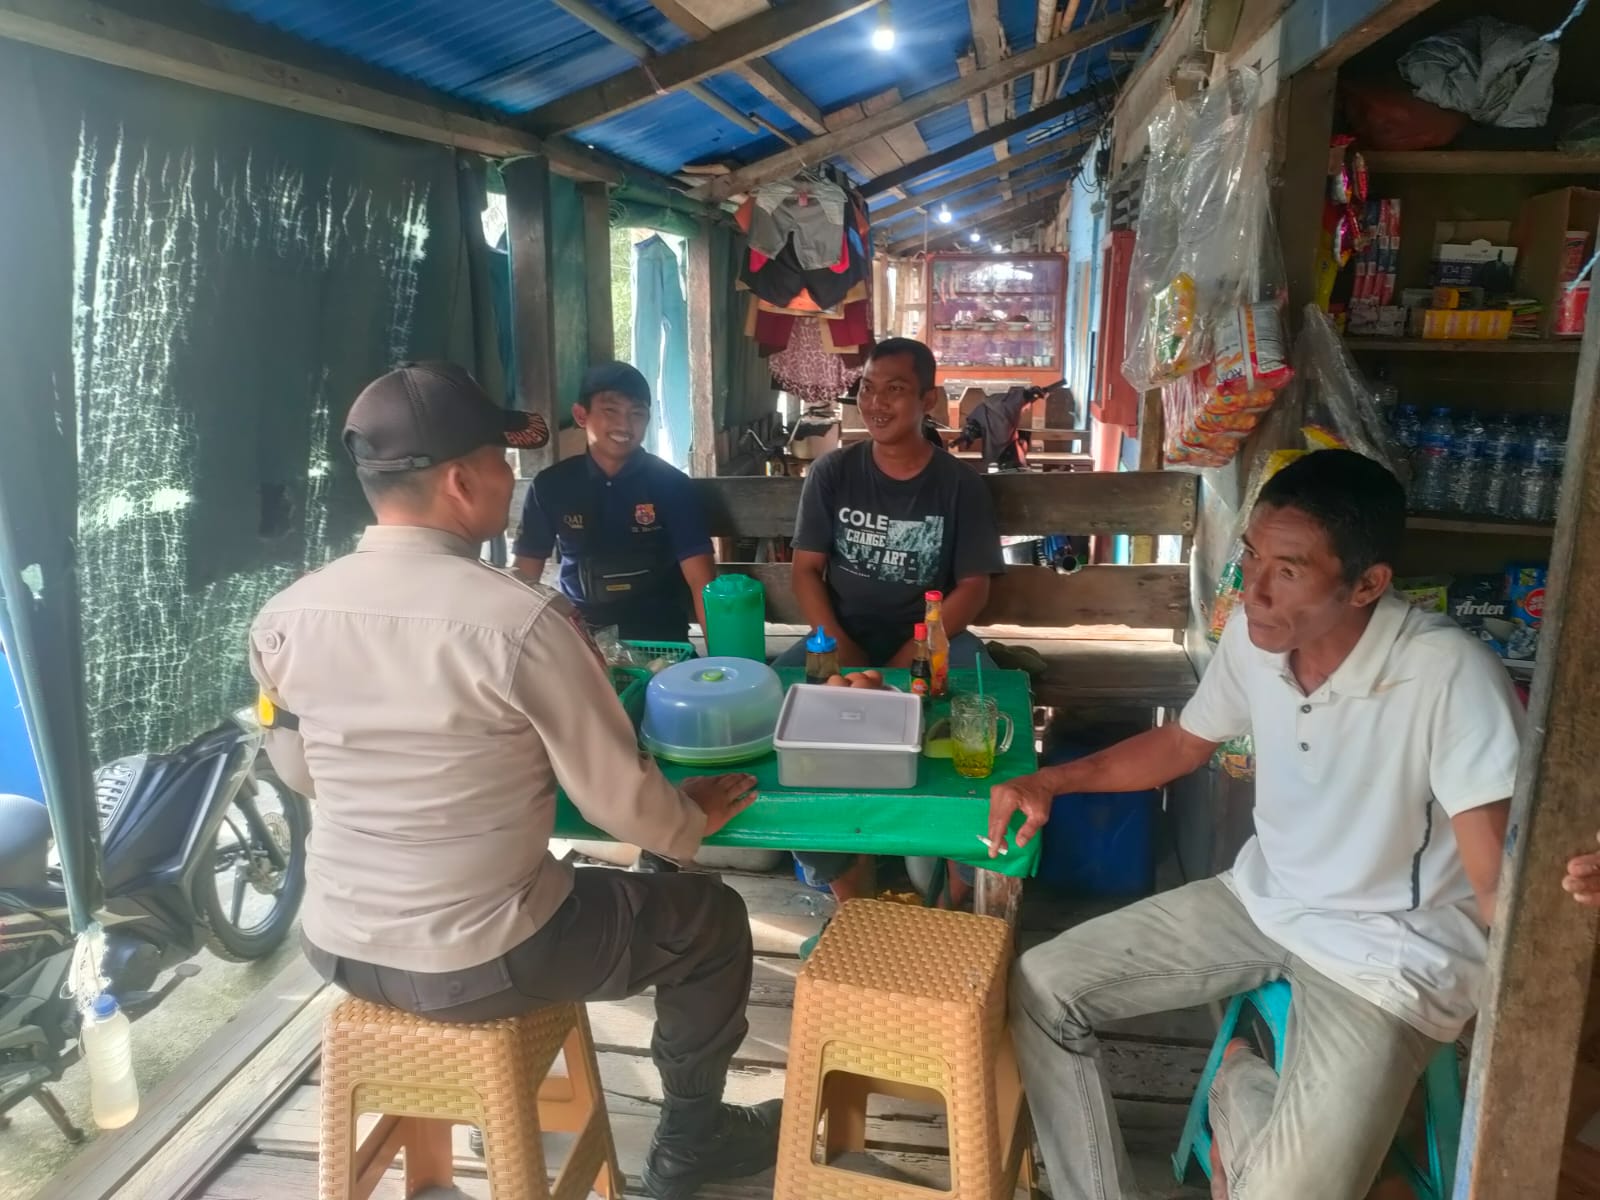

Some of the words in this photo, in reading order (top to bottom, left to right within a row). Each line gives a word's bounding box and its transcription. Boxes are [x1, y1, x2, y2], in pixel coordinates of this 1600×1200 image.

[839, 507, 889, 530] COLE
[846, 529, 887, 547] CHANGE
[882, 550, 908, 566] ART
[1455, 601, 1505, 616] Arden
